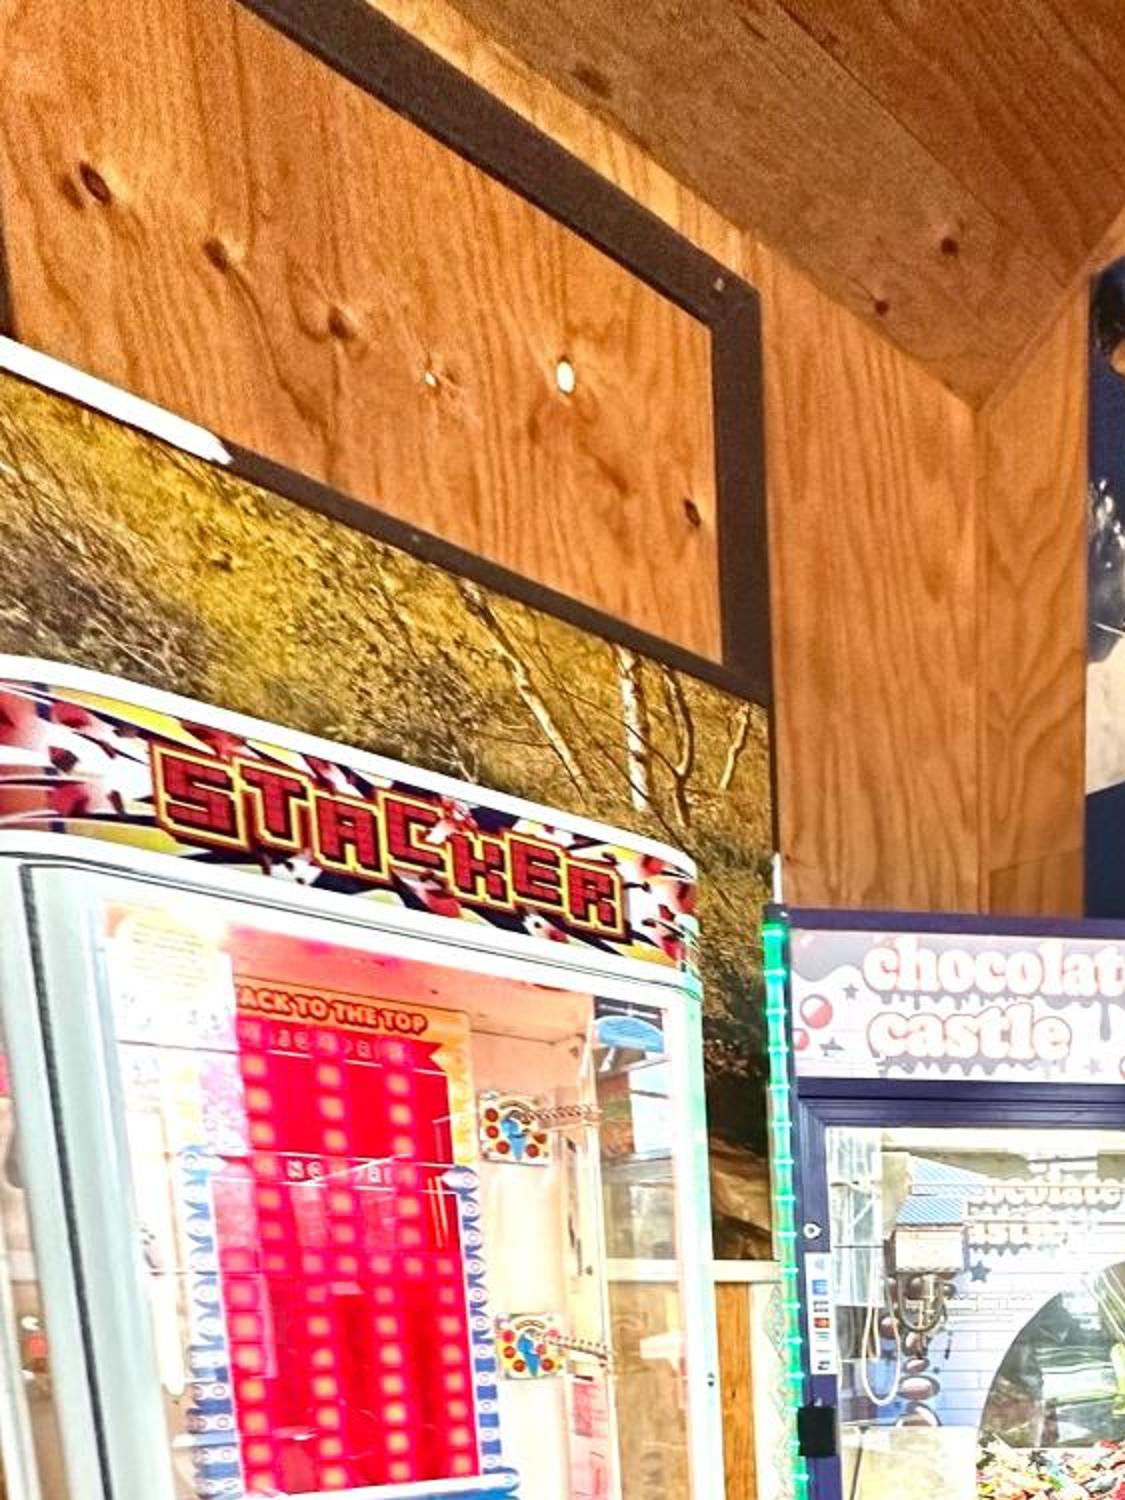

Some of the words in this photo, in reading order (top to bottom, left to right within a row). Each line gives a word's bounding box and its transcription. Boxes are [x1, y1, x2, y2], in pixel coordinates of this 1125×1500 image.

[152, 740, 628, 942] STACKER
[237, 985, 294, 1016] ACK
[294, 995, 329, 1020] TO
[330, 1000, 379, 1028] THE
[379, 1009, 428, 1034] TOP
[867, 1002, 1074, 1061] castle
